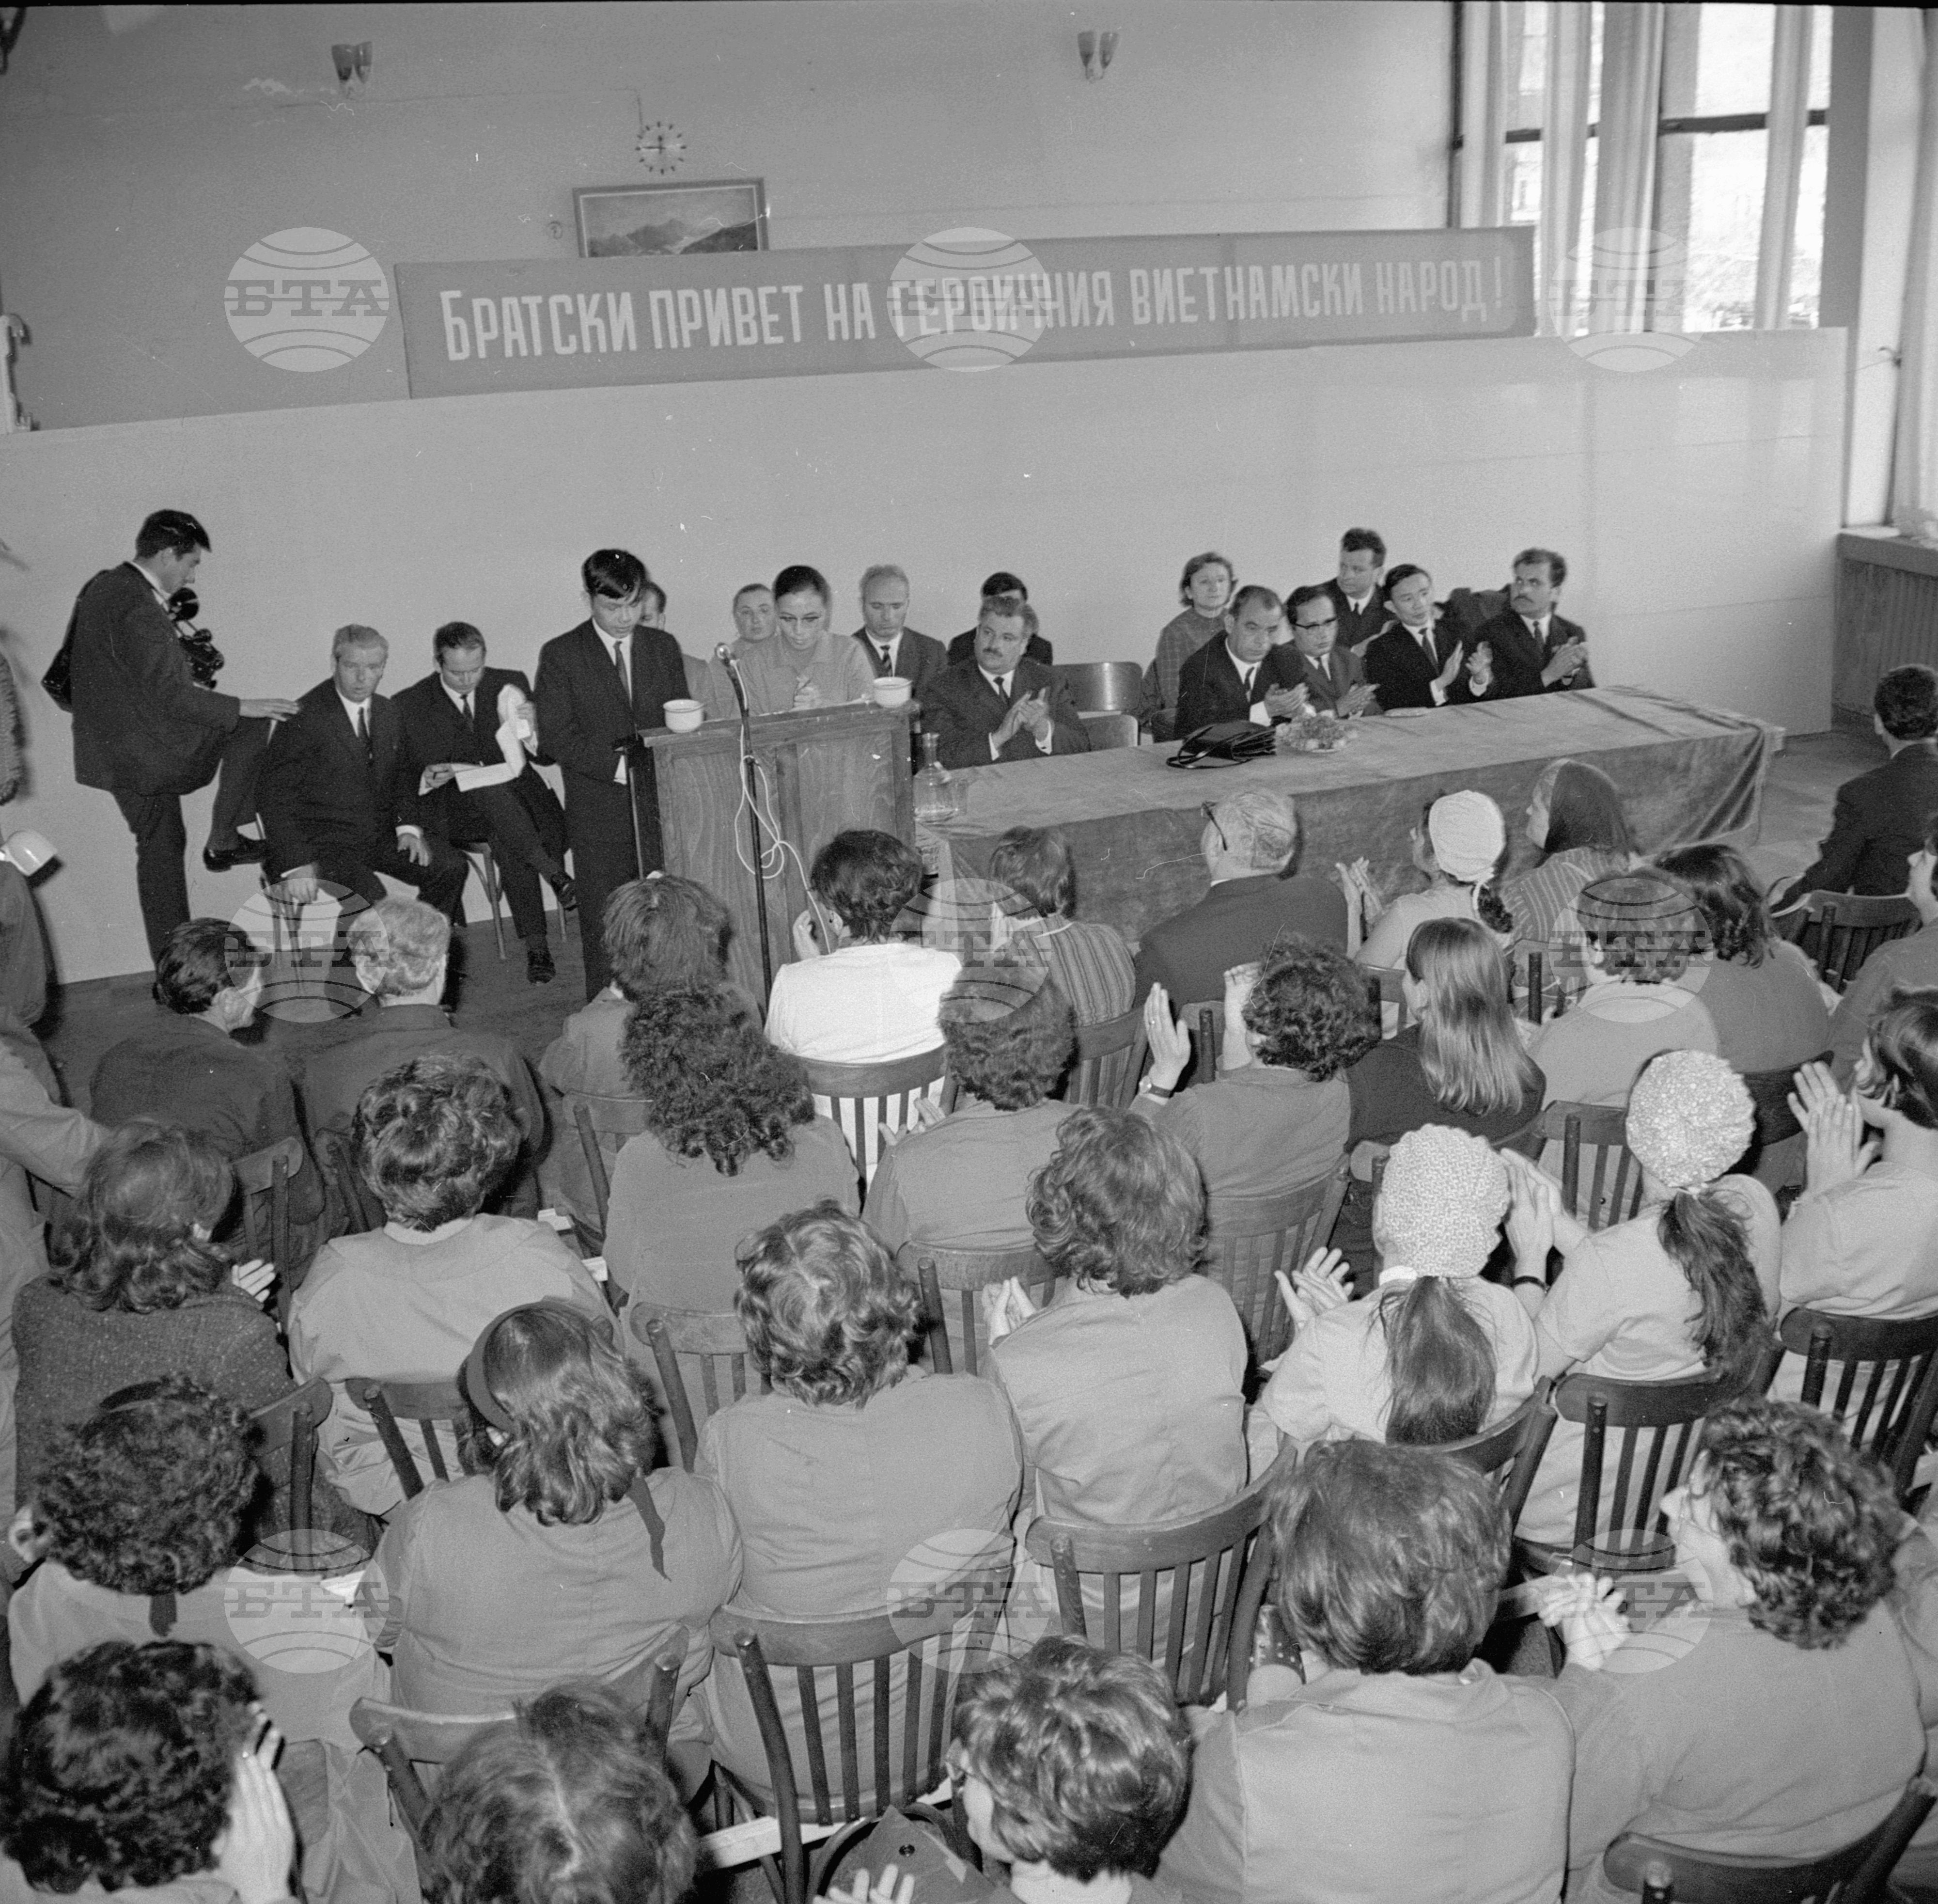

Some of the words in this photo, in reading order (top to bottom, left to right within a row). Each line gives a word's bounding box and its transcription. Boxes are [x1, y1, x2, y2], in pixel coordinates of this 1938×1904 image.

[440, 290, 638, 361] БРАТСКИ
[649, 285, 804, 349] ПРИВЕТ
[824, 283, 875, 341] НА
[1129, 263, 1362, 325] ВИЕТНАМСКИ
